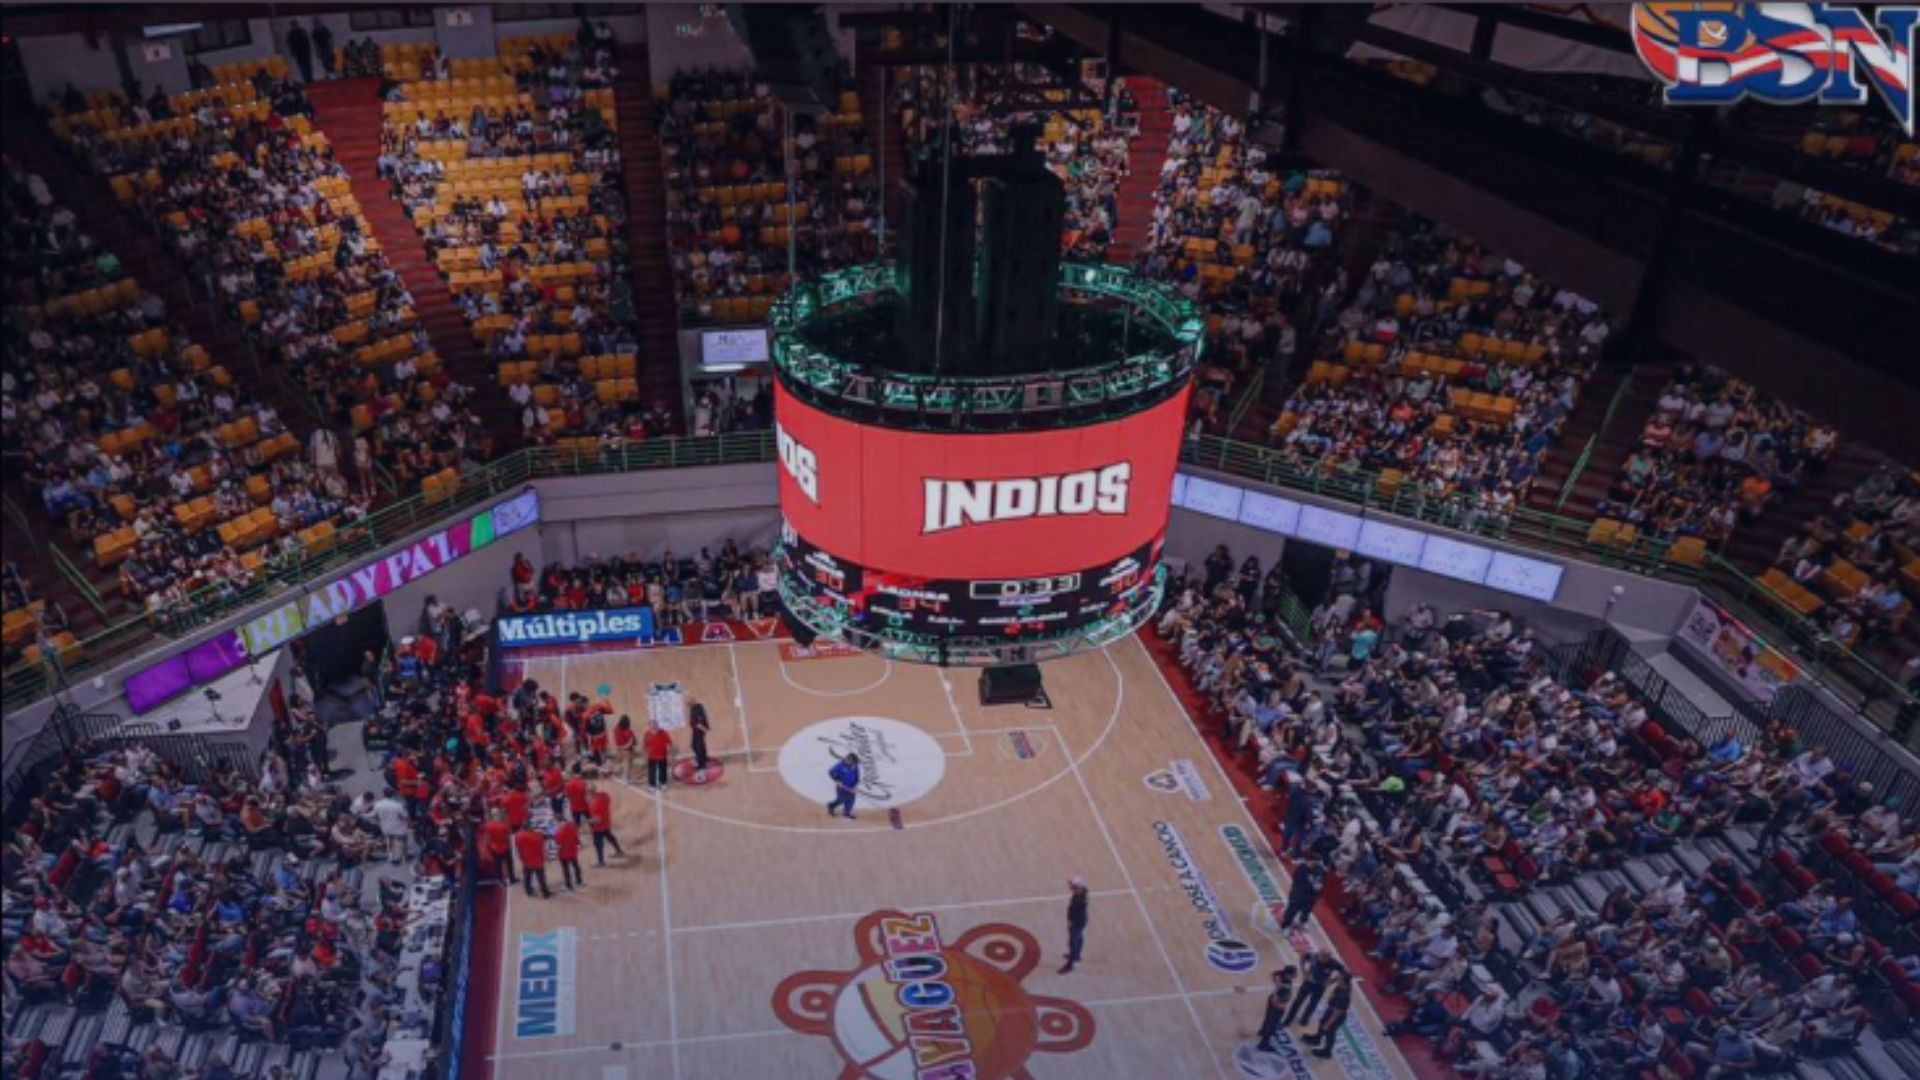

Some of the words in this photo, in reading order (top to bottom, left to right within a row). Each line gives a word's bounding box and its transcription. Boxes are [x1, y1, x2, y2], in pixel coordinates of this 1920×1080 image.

[922, 461, 1131, 534] INDIOS
[499, 612, 641, 642] Múltiples
[517, 930, 558, 1037] MEDX
